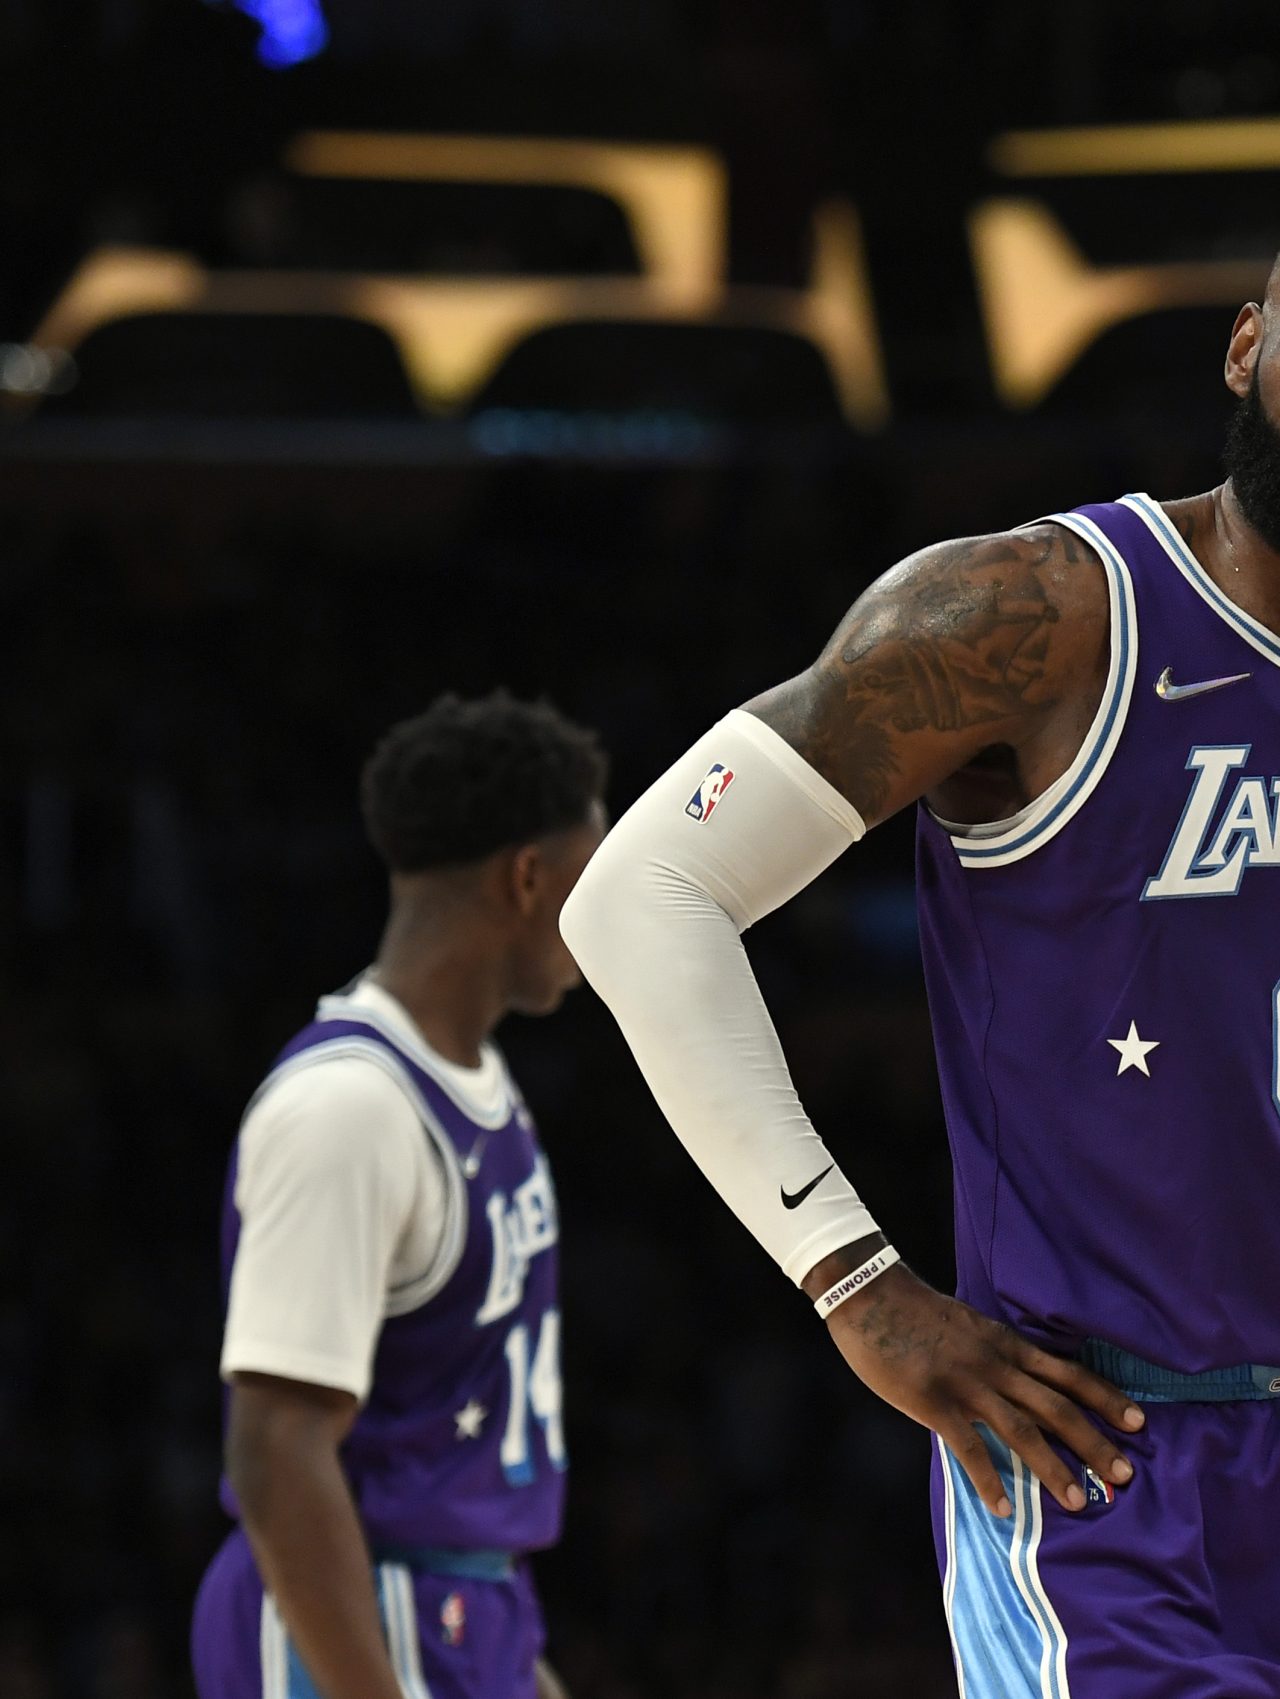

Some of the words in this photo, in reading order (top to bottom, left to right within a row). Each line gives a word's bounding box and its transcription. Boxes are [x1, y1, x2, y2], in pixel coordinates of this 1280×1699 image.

[878, 1256, 886, 1266] I
[823, 1261, 880, 1308] PROMISE
[1088, 1487, 1100, 1502] 75
